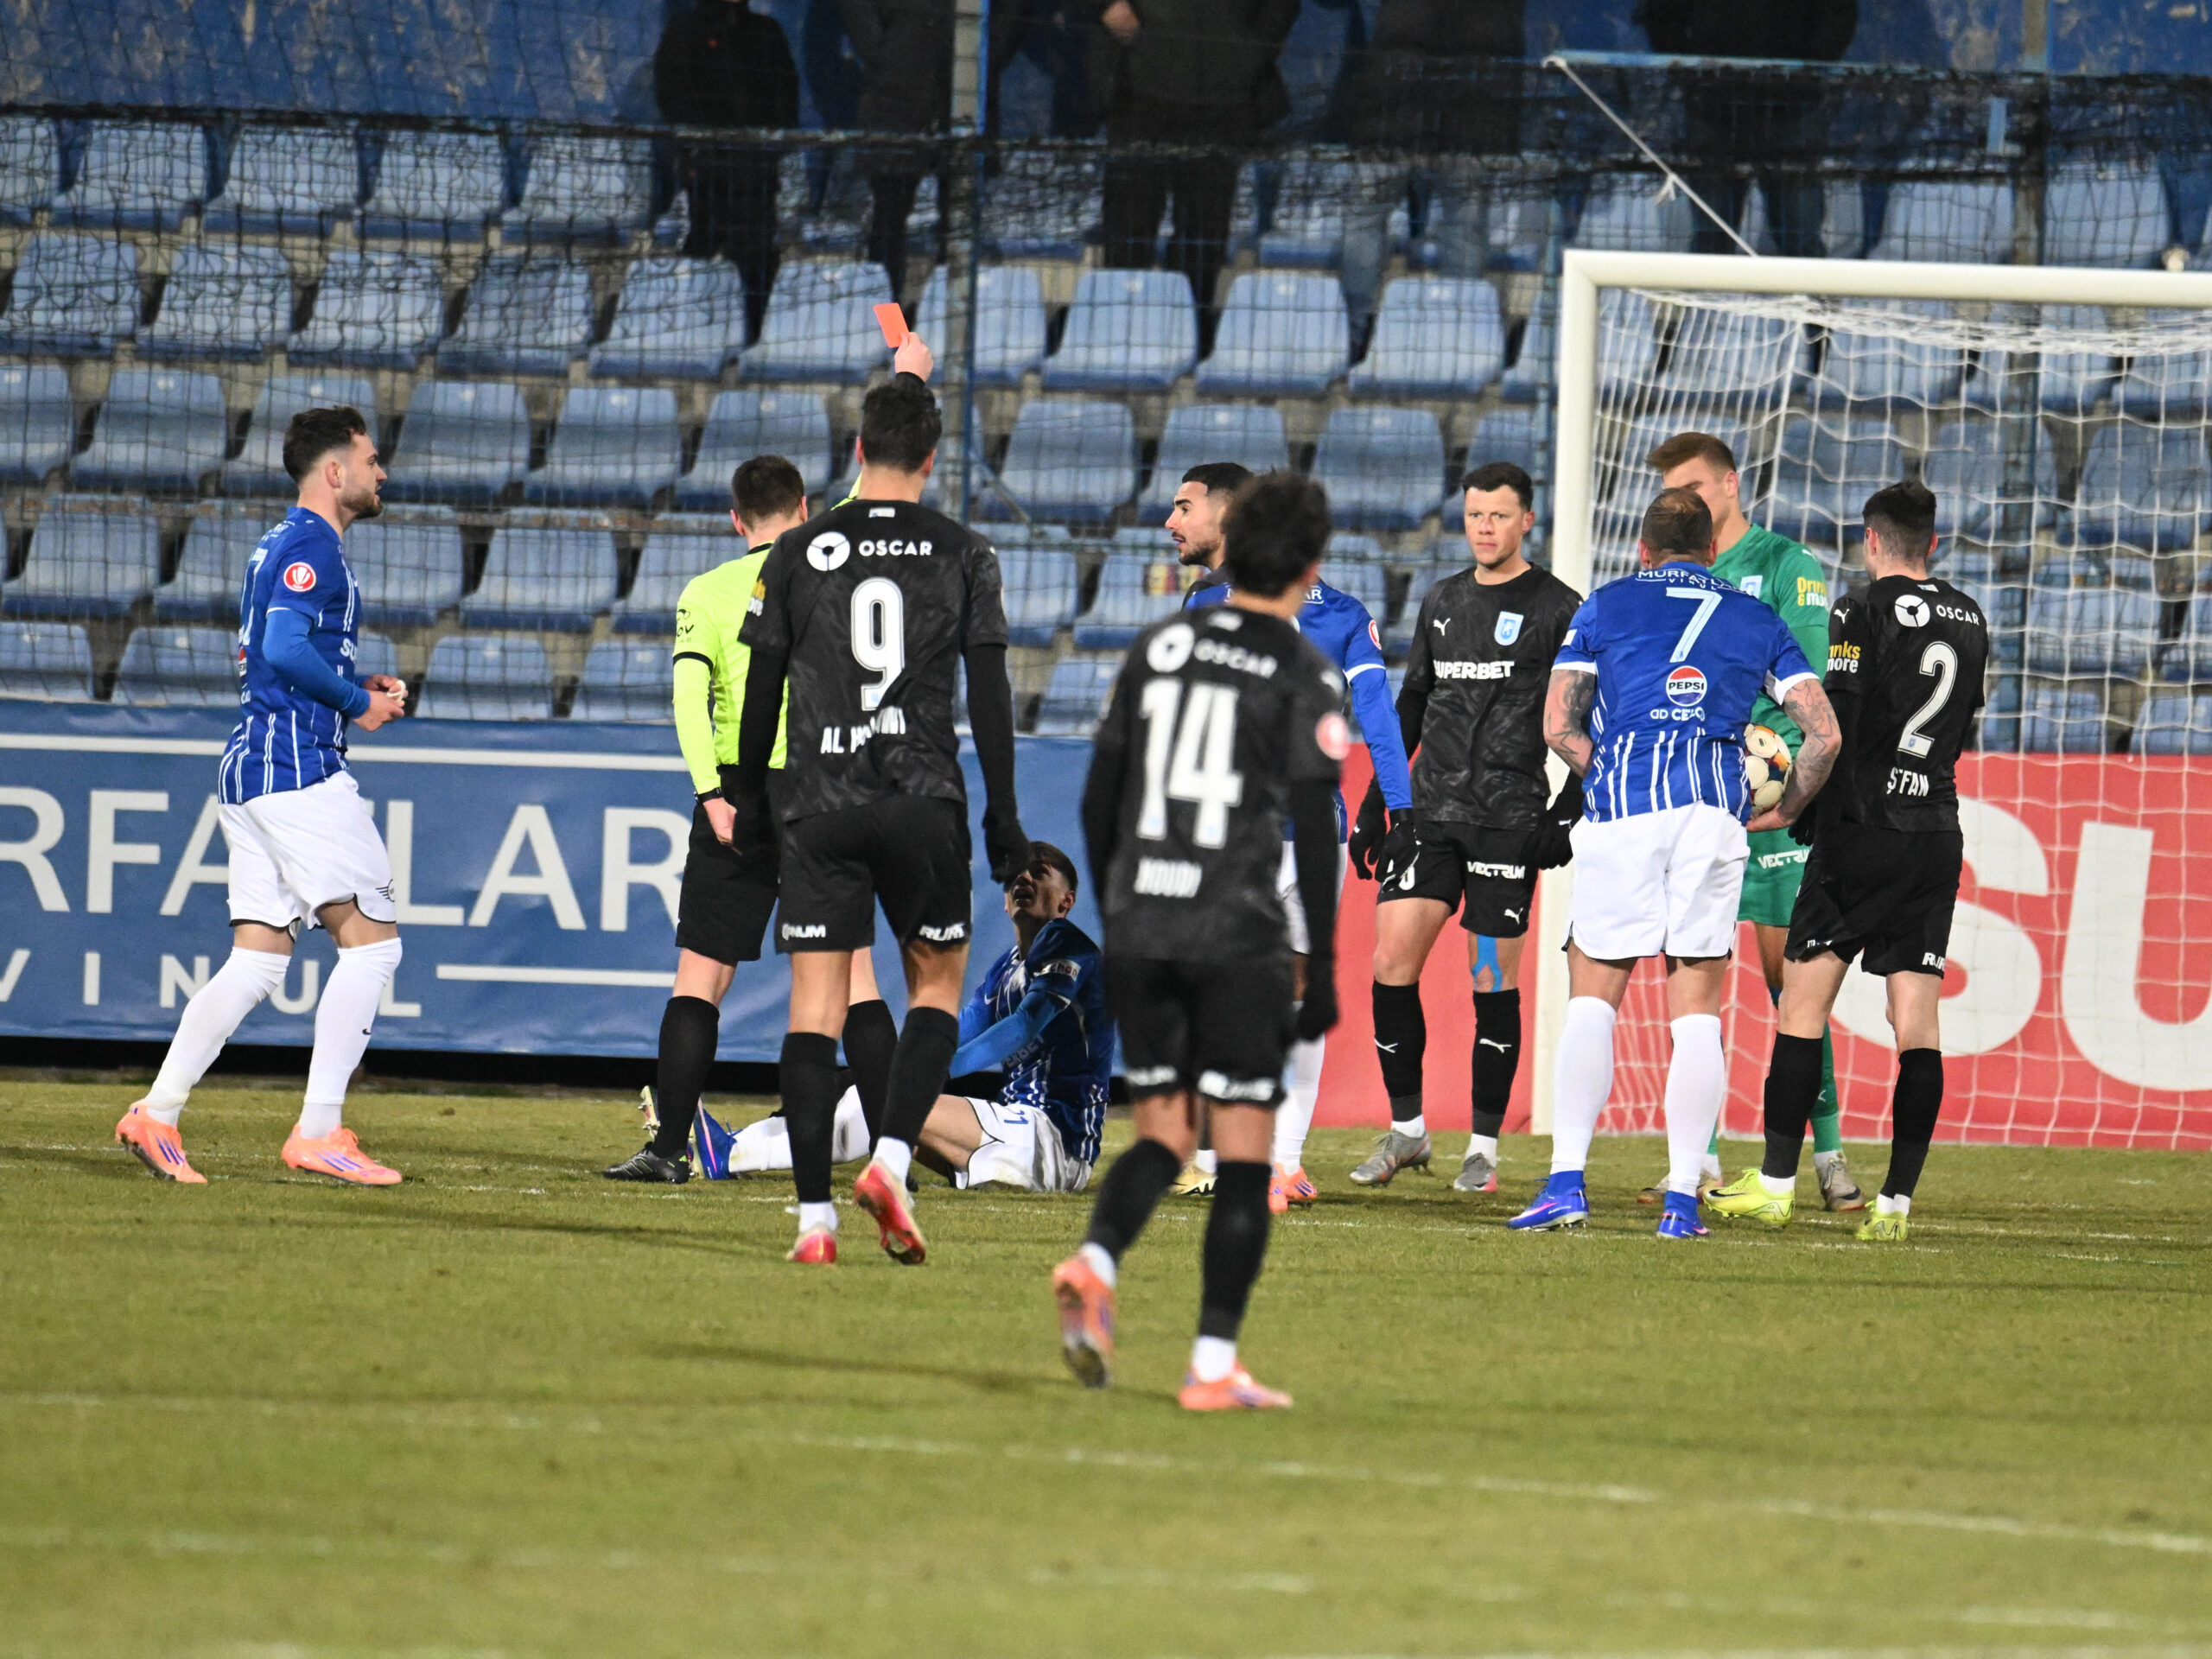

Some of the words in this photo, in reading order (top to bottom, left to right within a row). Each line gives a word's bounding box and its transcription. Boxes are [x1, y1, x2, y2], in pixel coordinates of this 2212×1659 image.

[858, 538, 933, 557] OSCAR
[1666, 587, 1723, 664] 7
[1936, 604, 1980, 626] OSCAR
[851, 576, 906, 711] 9
[1433, 659, 1515, 680] UPERBET
[1669, 681, 1705, 690] PEPSI
[1897, 641, 1958, 759] 2
[821, 726, 845, 754] AL
[1136, 676, 1243, 849] 14
